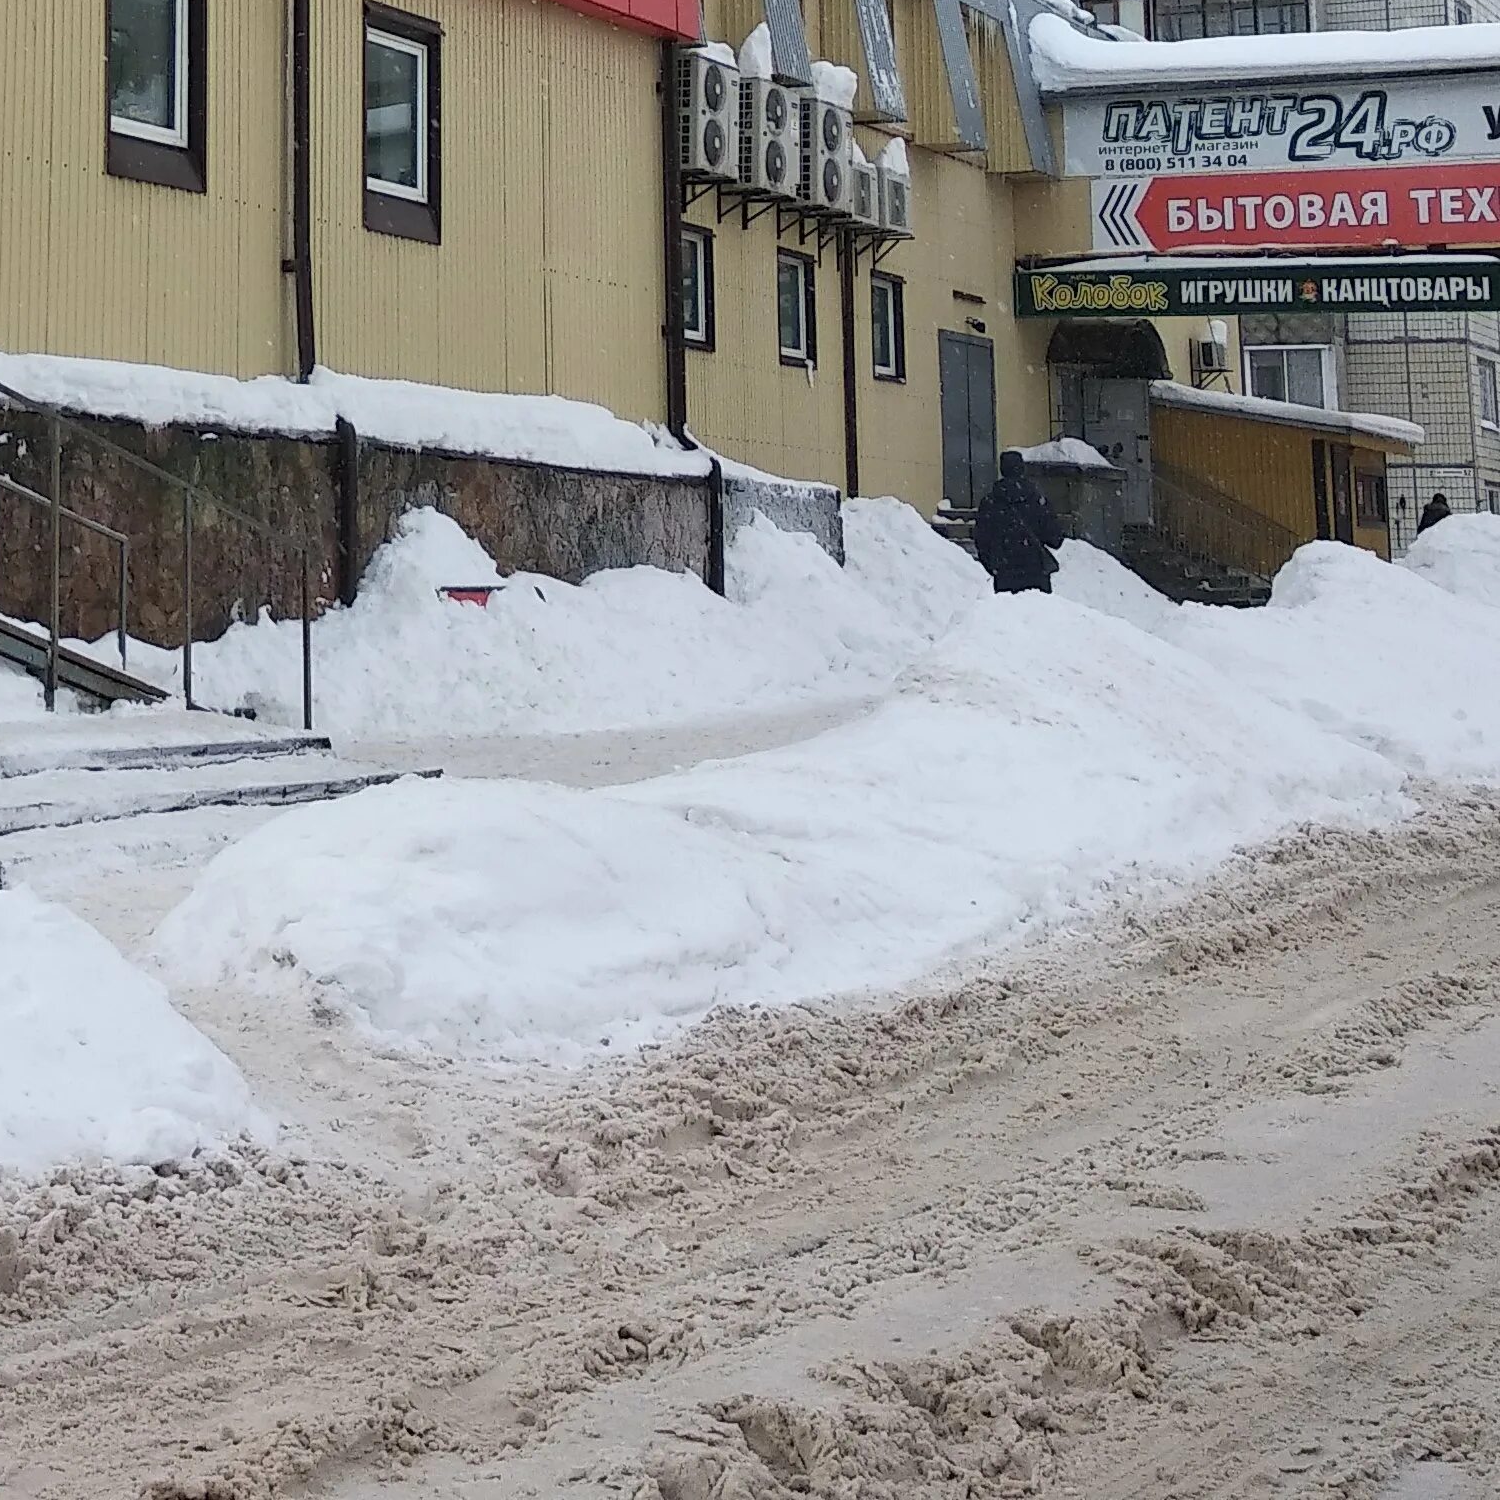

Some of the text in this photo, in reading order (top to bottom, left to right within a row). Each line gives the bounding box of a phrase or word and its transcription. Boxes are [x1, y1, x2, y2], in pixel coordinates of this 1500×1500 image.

[1098, 140, 1258, 156] интернет магазин
[1105, 154, 1247, 172] 8 (800) 511 34 04
[1167, 186, 1499, 232] БЫТОВАЯ ТЕХ
[1031, 274, 1169, 311] Колобок
[1180, 276, 1491, 307] ИГРУШКИ КАНЦТОВАРЫ
